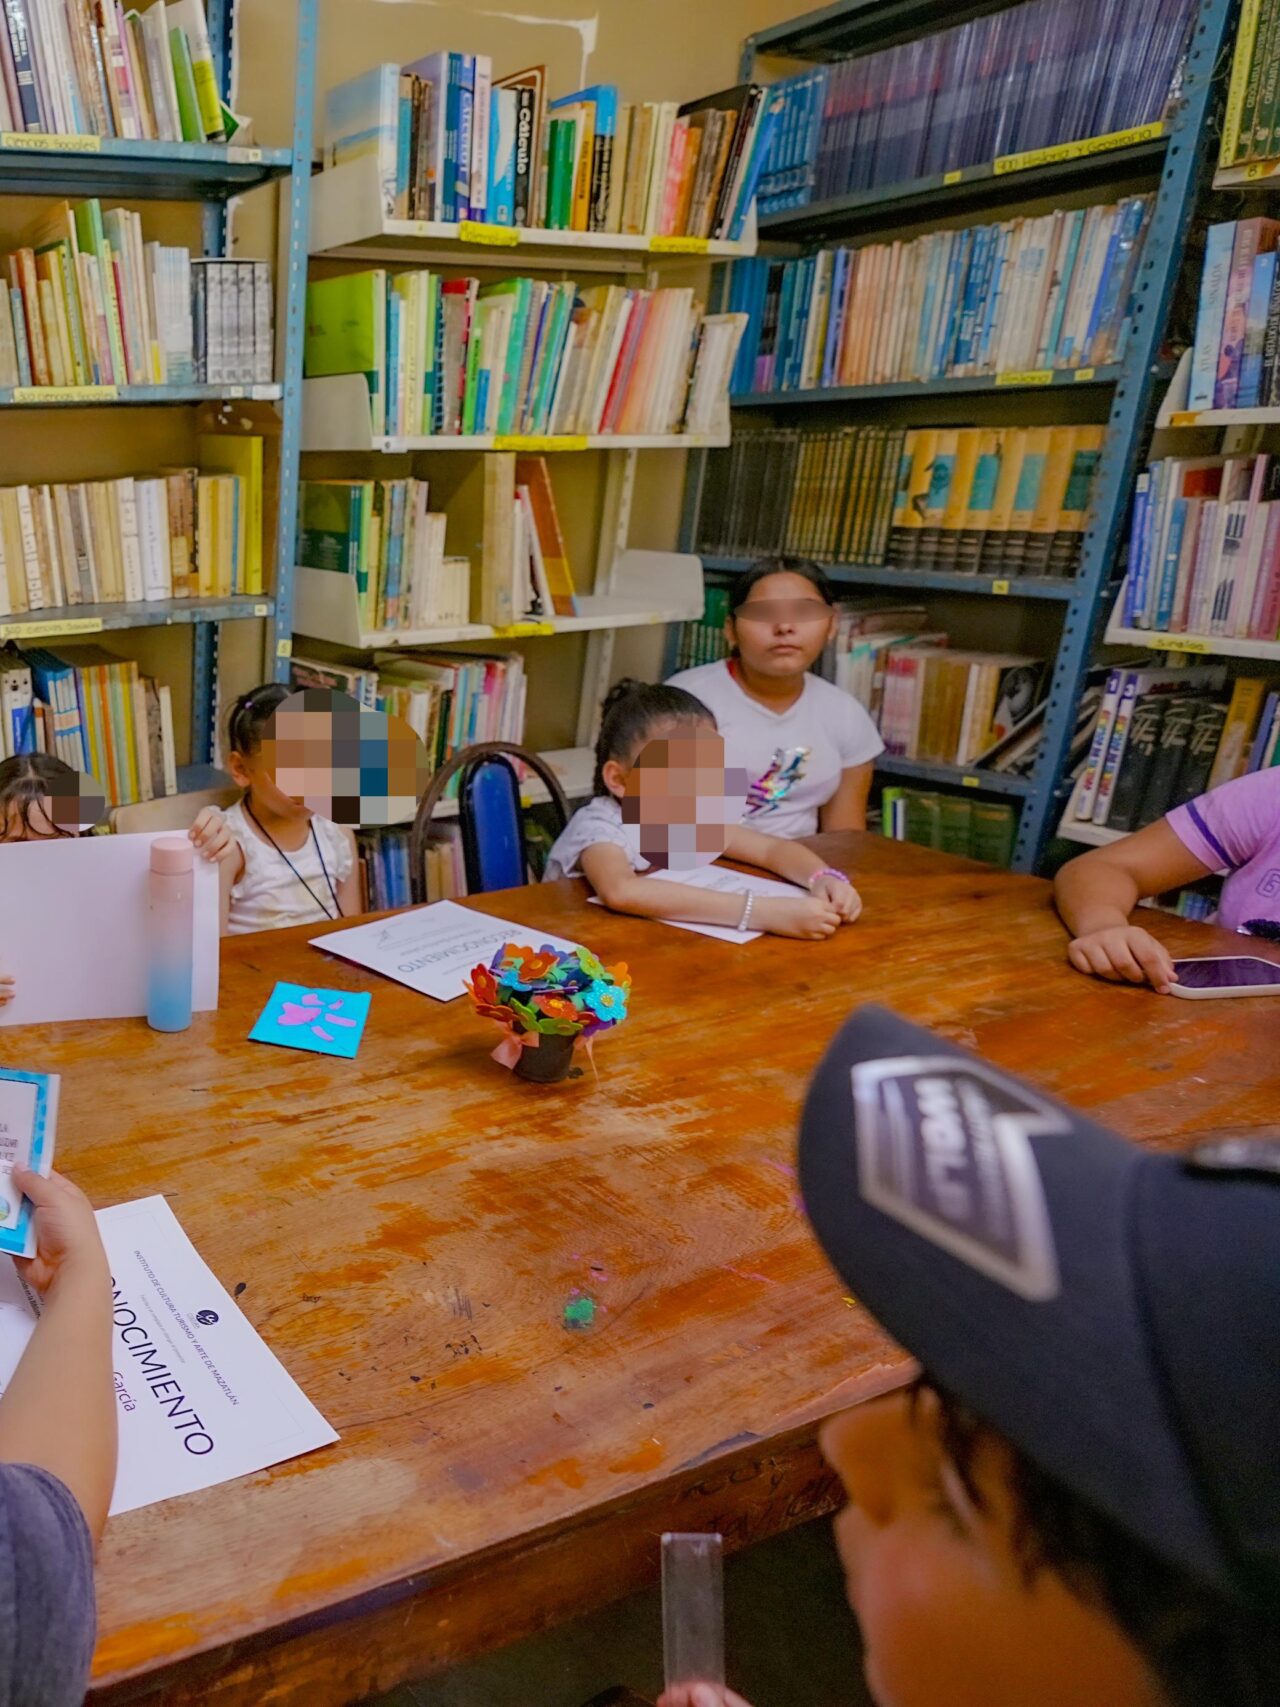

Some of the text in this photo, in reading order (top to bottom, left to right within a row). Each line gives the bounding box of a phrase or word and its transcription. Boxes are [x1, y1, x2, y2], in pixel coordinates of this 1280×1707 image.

[1124, 685, 1134, 697] 3
[110, 1276, 214, 1456] NOCIMIENTO
[133, 1248, 156, 1281] INSTITUTO
[156, 1285, 177, 1314] CULTURA
[172, 1311, 195, 1341] TURISMO
[193, 1342, 209, 1362] ARTE
[210, 1366, 240, 1408] MAZATLÁN
